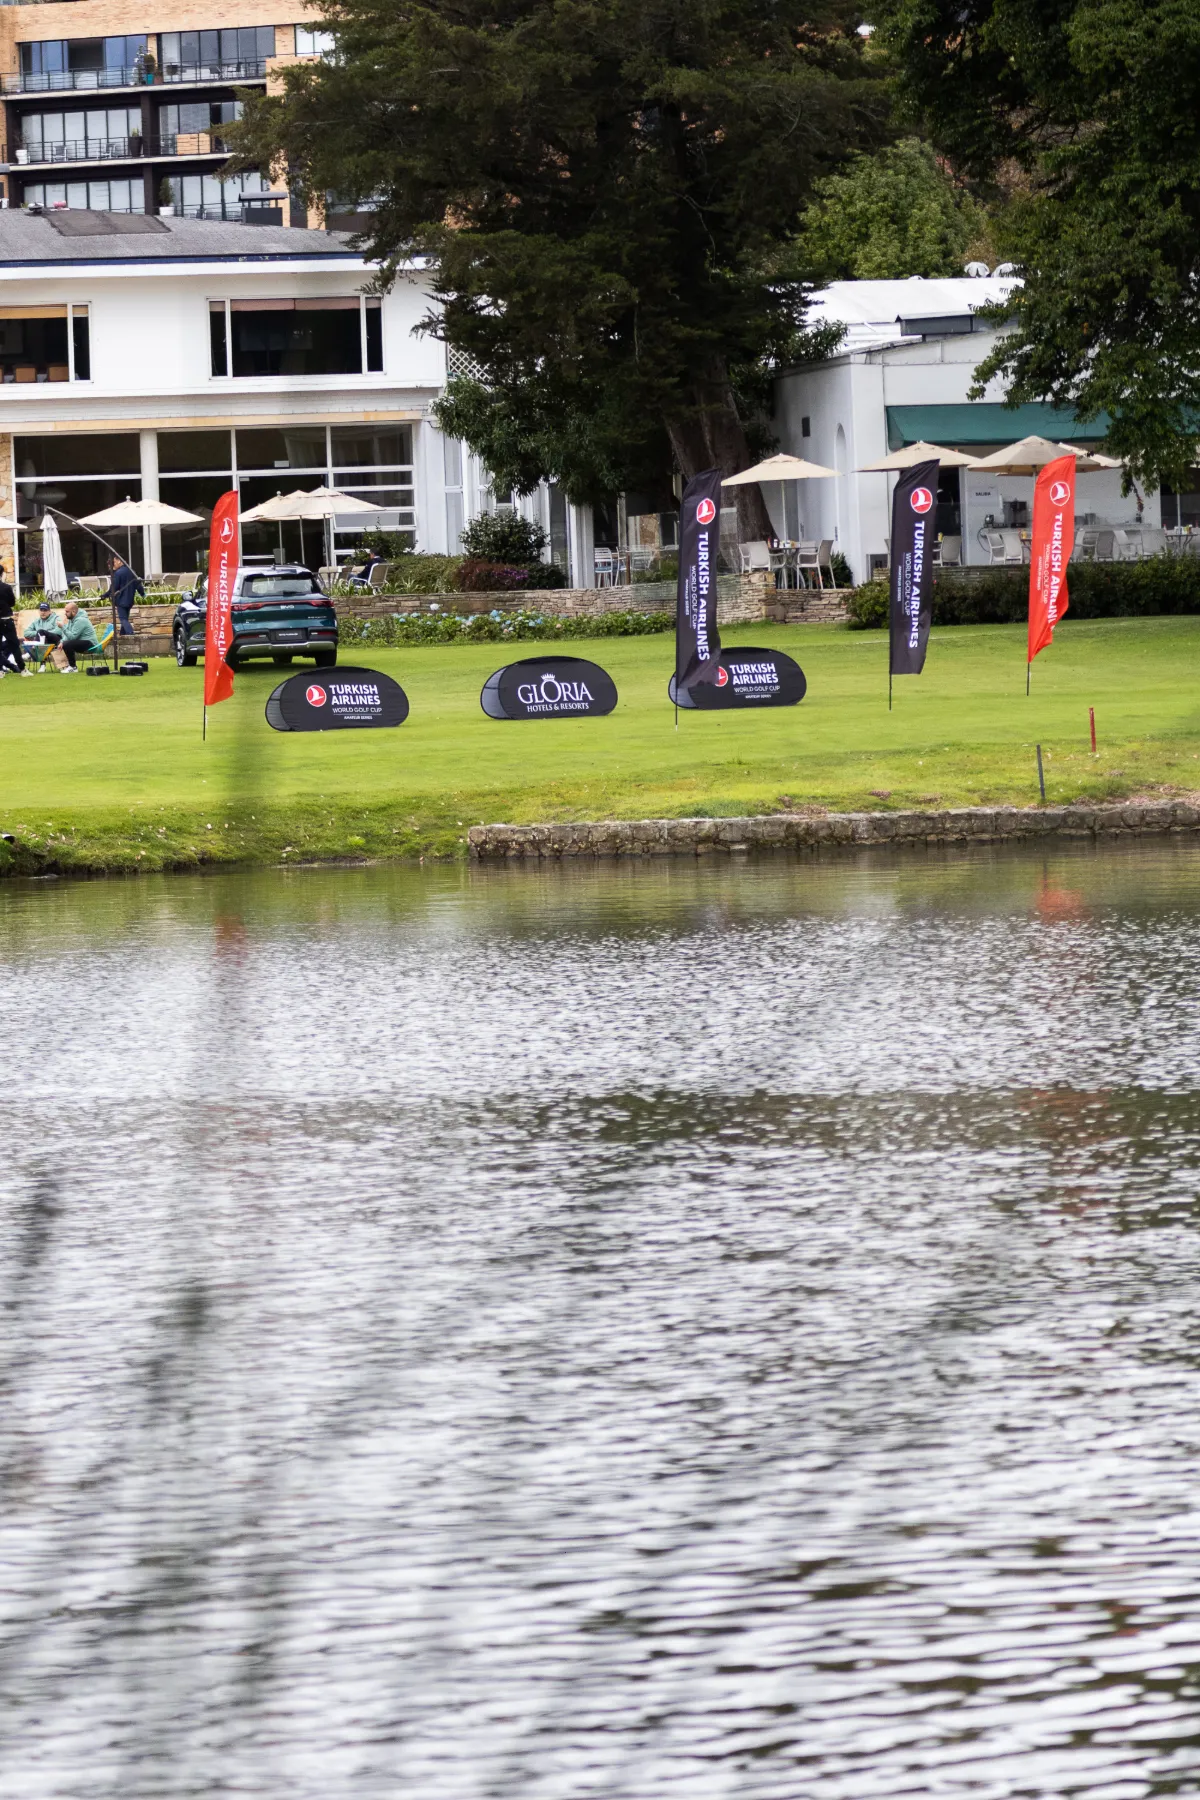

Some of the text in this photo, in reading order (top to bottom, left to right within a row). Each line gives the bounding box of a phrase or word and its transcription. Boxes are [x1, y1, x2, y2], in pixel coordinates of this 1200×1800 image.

[1051, 512, 1063, 572] TURKISH
[219, 551, 229, 612] TURKISH
[909, 520, 925, 648] TURKISH AIRLINES
[696, 531, 710, 661] TURKISH AIRLINES
[729, 663, 776, 675] TURKISH
[732, 673, 779, 686] AIRLINES
[329, 684, 379, 695] TURKISH
[517, 679, 595, 704] GLORIA
[331, 695, 381, 705] AIRLINES
[527, 702, 590, 713] HOTELS & RESORTS
